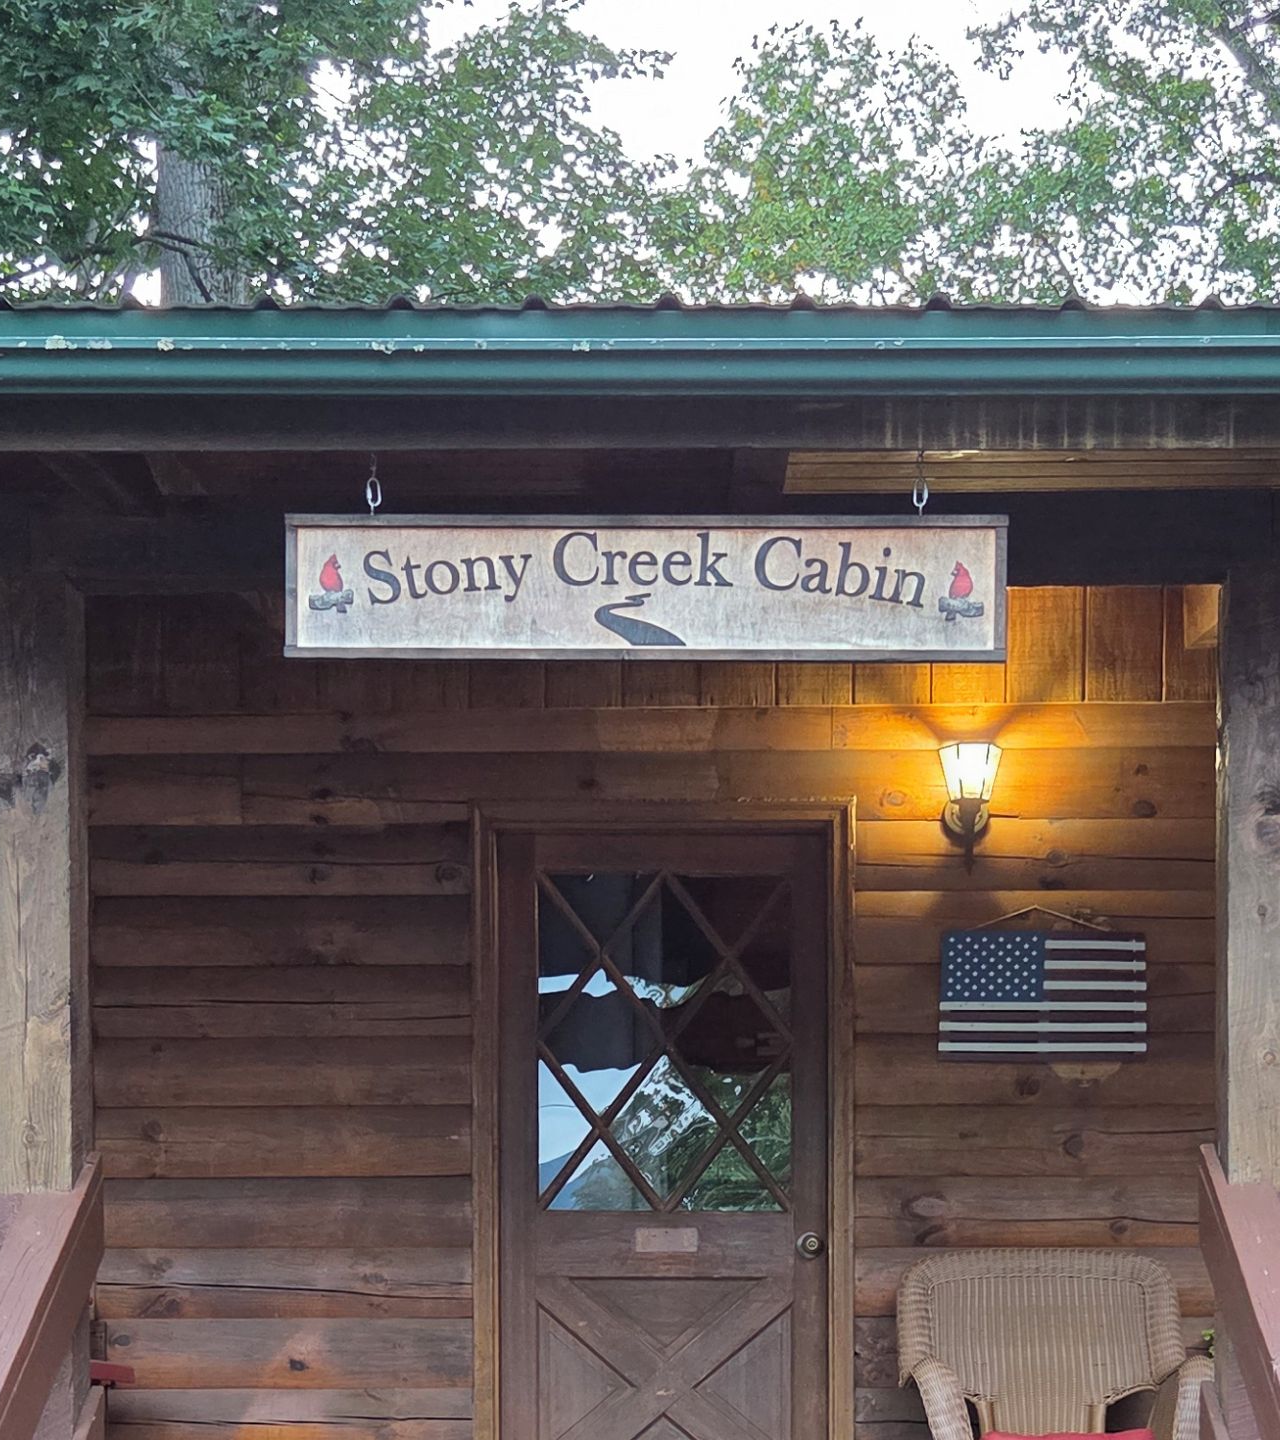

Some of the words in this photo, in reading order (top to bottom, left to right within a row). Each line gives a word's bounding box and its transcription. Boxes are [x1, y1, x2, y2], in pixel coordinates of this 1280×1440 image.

[362, 549, 532, 606] Stony
[553, 531, 734, 587] Creek
[754, 536, 926, 609] Cabin
